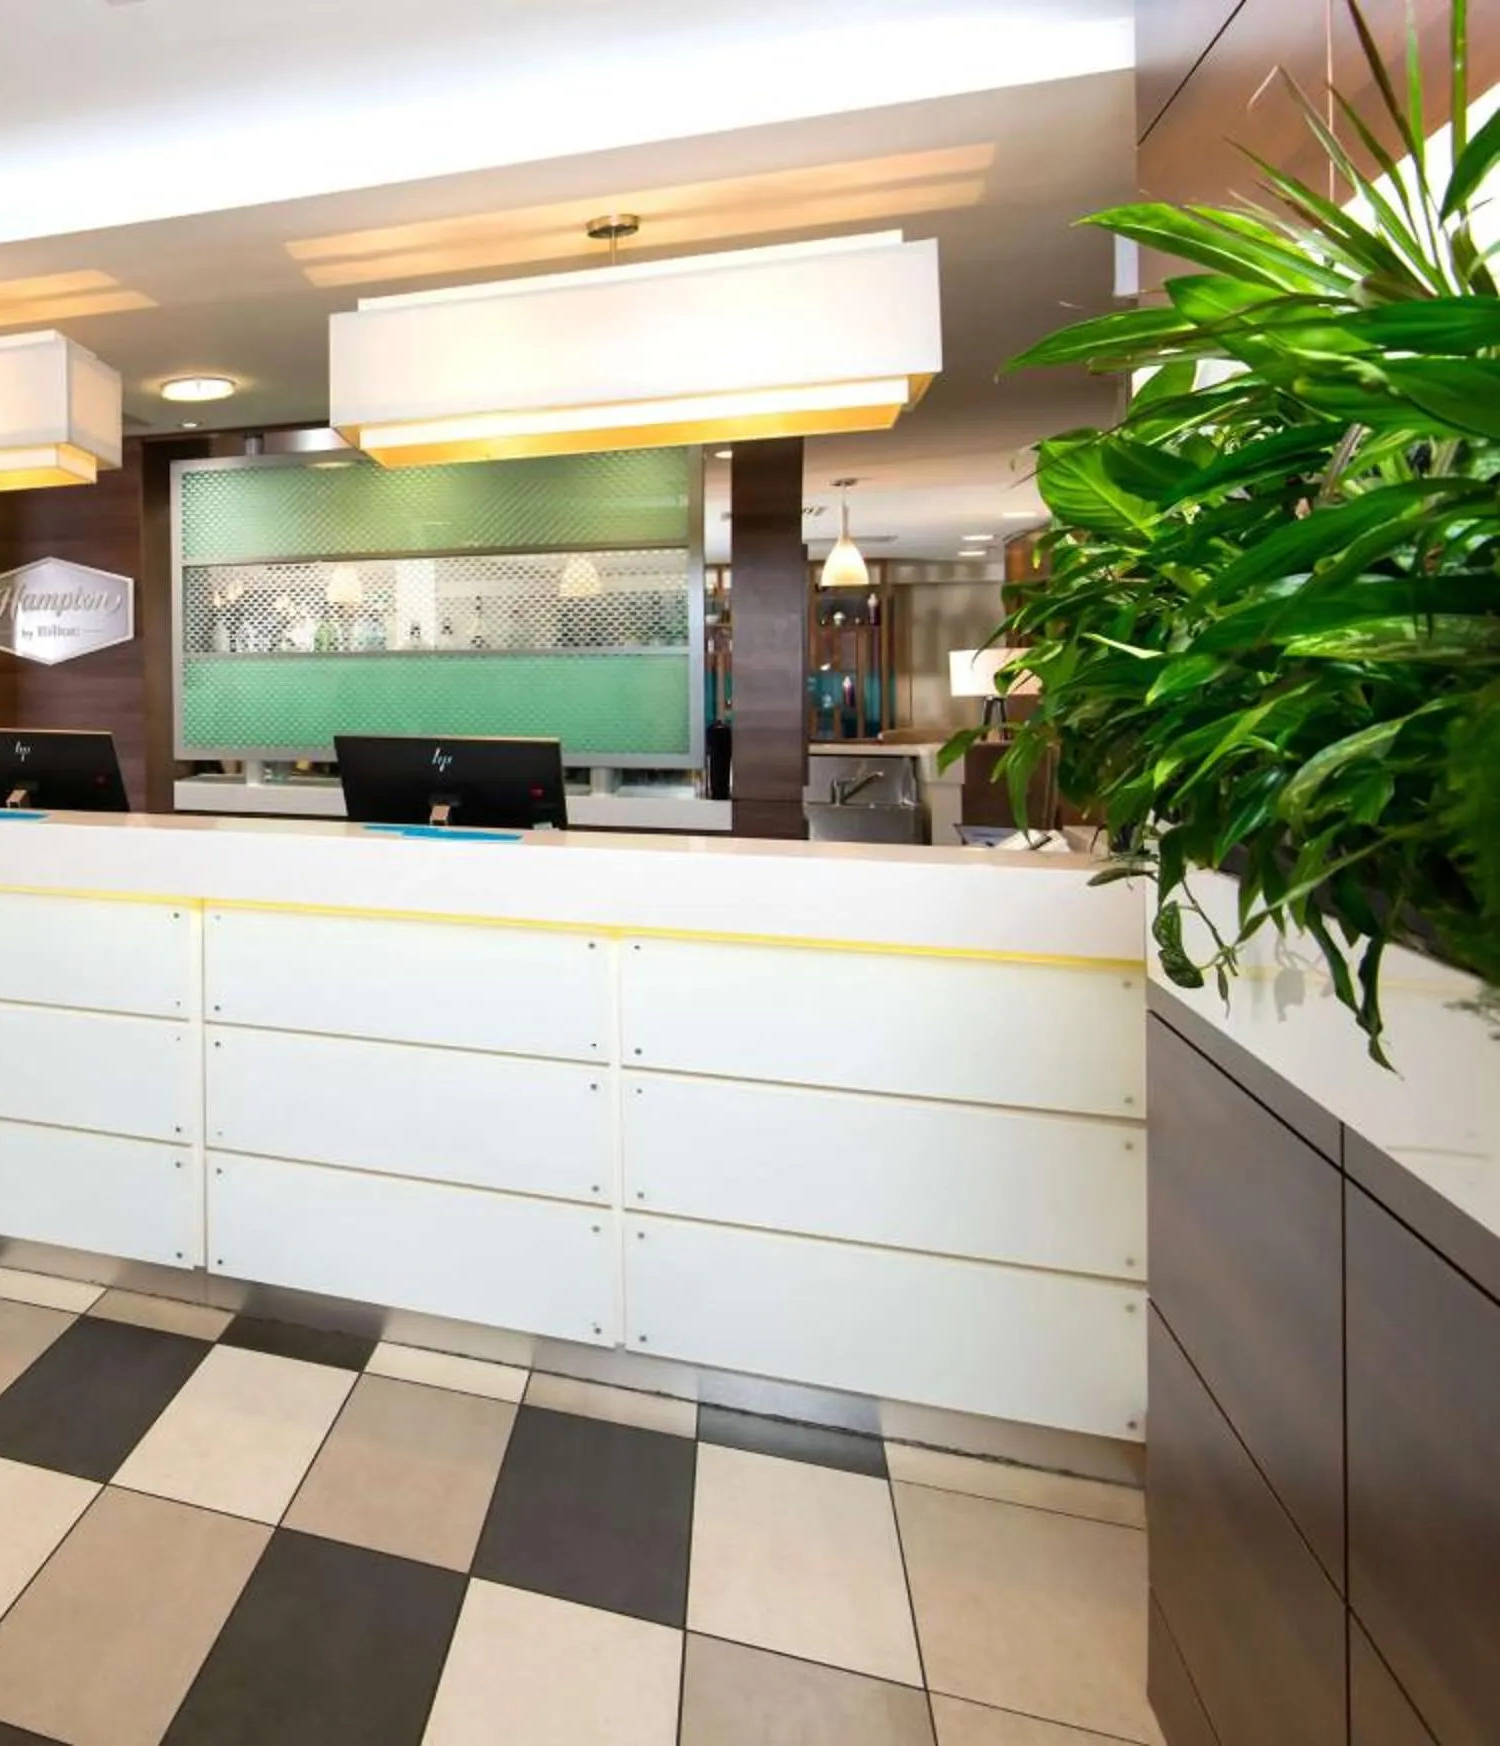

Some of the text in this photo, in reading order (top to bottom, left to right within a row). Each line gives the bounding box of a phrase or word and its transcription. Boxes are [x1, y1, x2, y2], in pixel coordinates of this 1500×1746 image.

[21, 628, 34, 641] by
[15, 740, 31, 762] hp
[432, 748, 452, 772] hp
